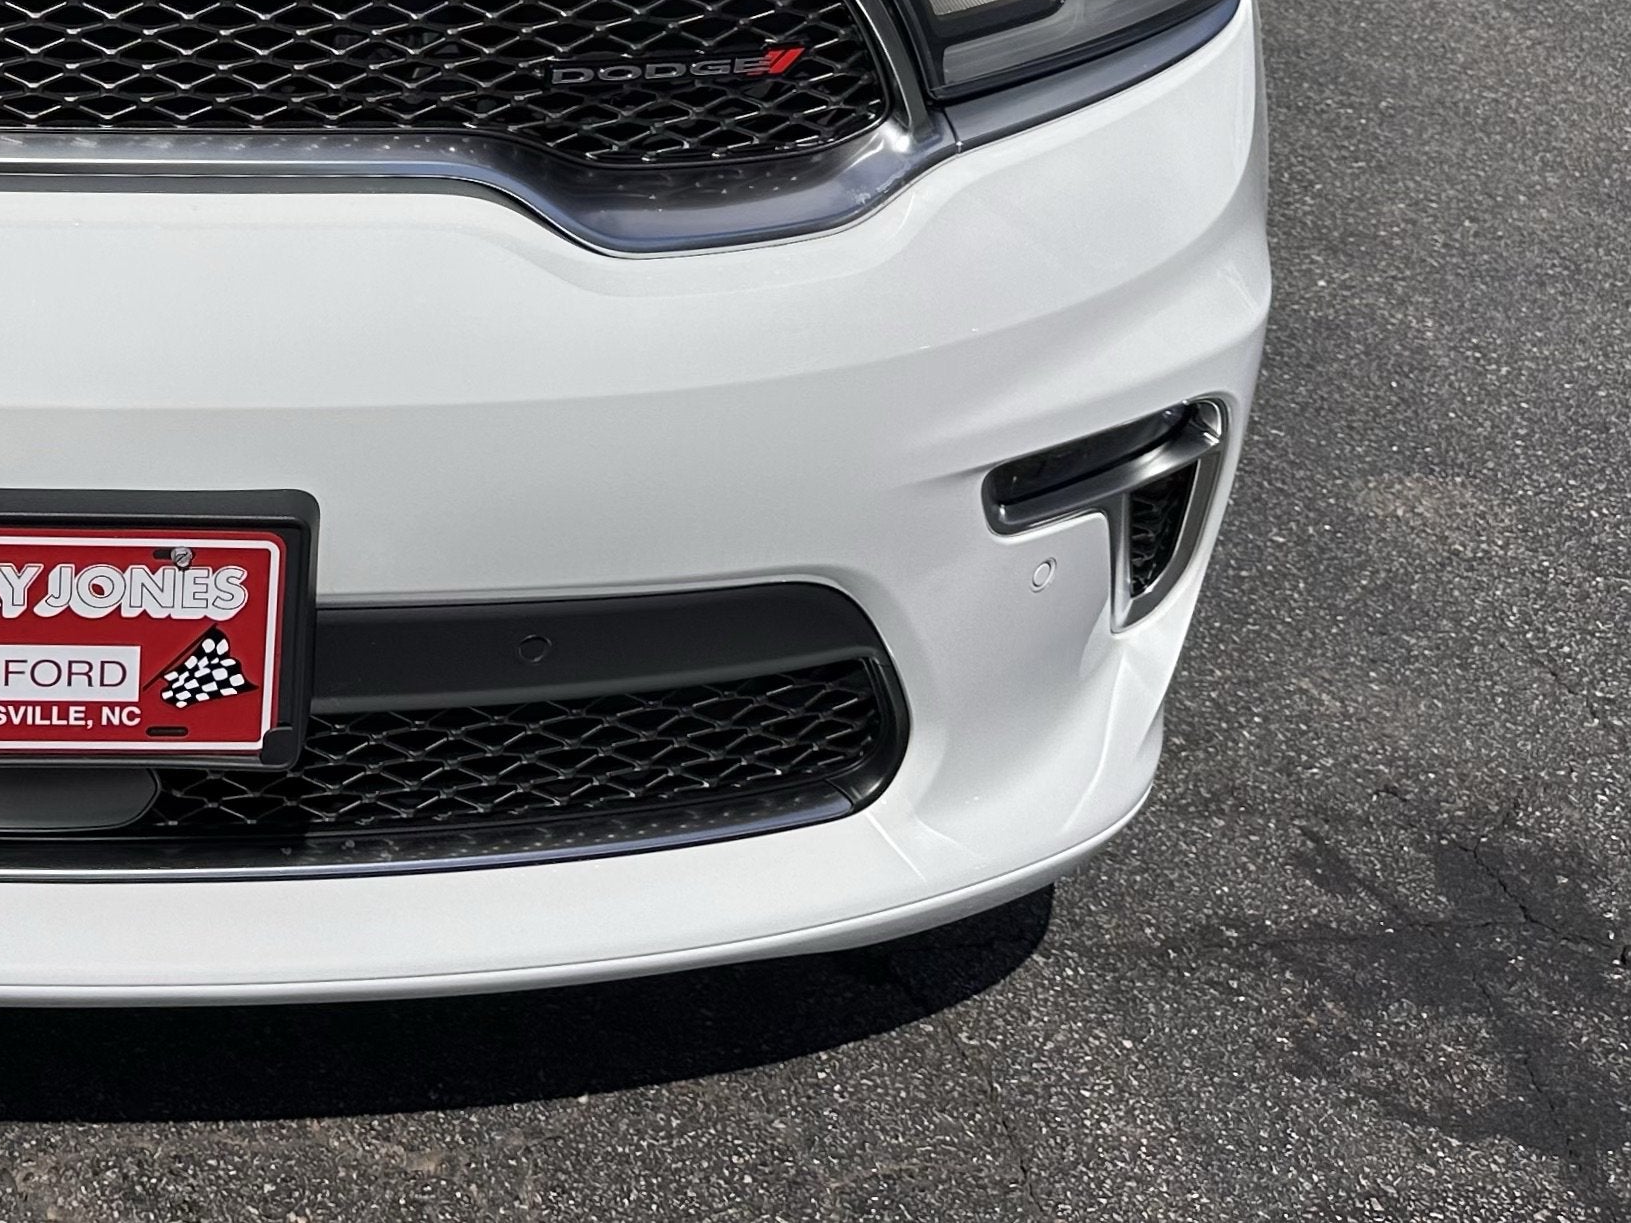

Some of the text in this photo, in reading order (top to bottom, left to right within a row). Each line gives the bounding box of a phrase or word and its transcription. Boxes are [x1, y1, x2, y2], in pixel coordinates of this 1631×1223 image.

[552, 56, 771, 84] DODGE
[33, 563, 248, 620] JONES
[4, 659, 128, 687] FORD
[101, 706, 142, 726] NC
